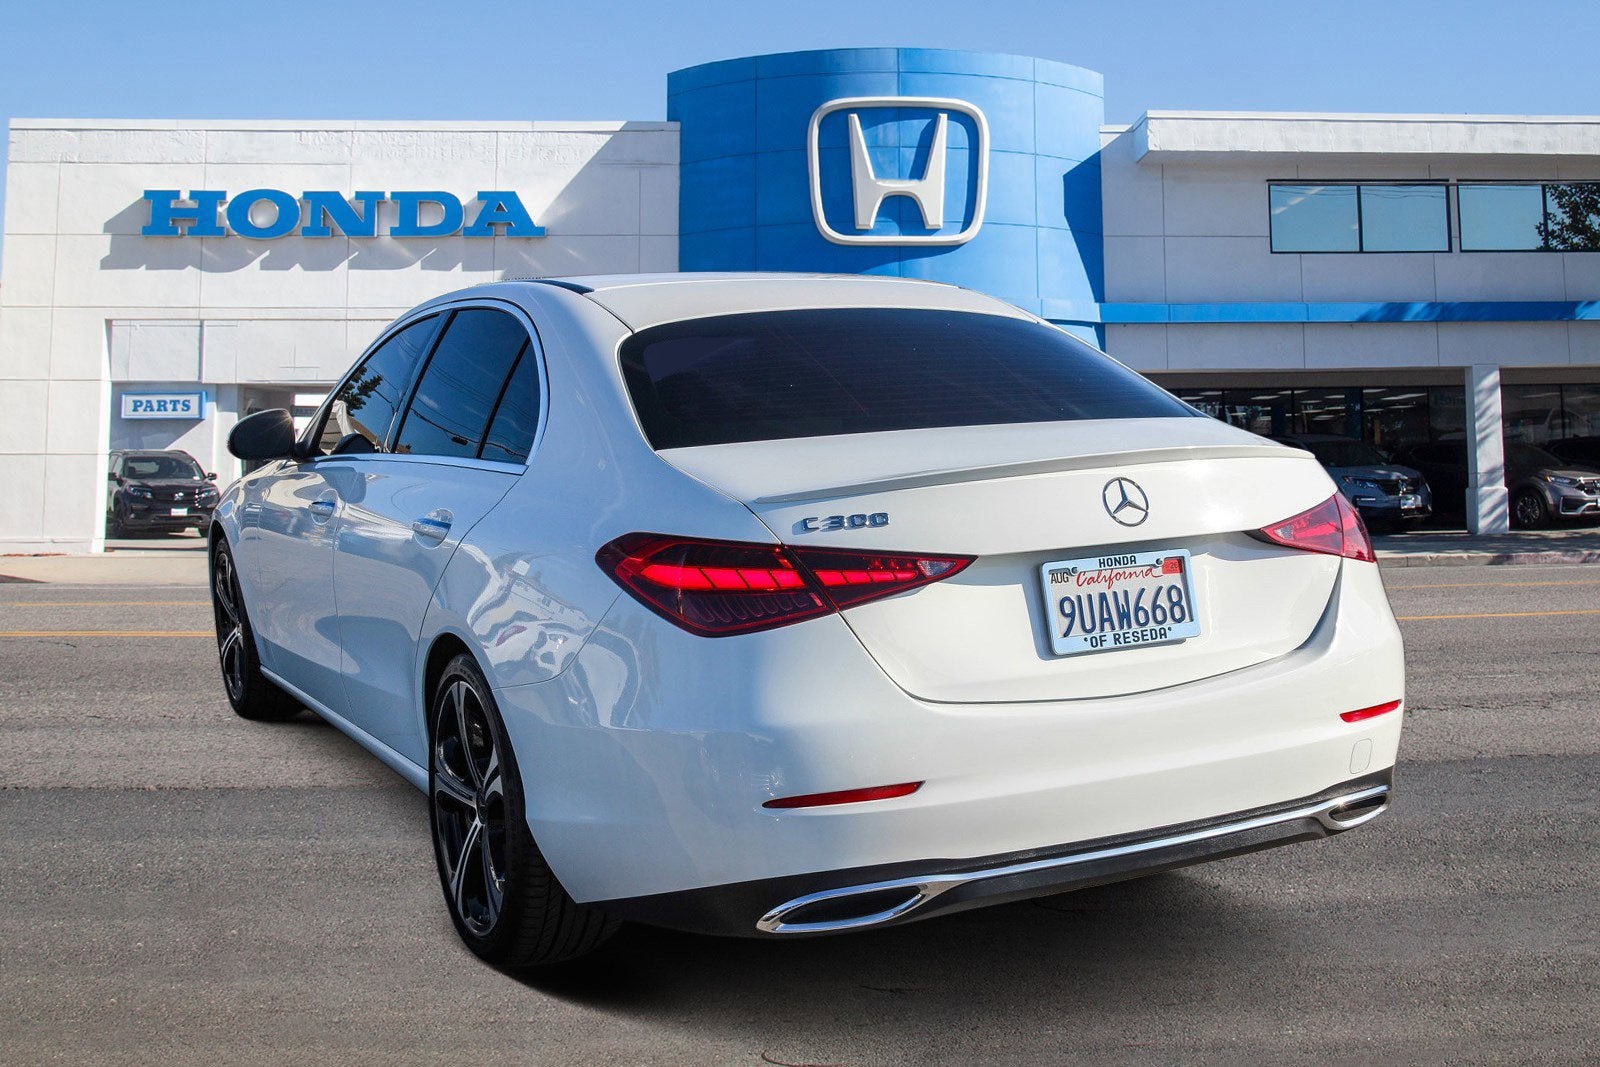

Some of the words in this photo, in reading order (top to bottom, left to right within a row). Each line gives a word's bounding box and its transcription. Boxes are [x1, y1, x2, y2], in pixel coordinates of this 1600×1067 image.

[142, 189, 547, 239] HONDA
[132, 399, 191, 412] PARTS
[1098, 555, 1137, 568] HONDA
[1050, 572, 1070, 584] AUG
[1076, 567, 1163, 589] California
[1059, 584, 1186, 638] 9UAW668
